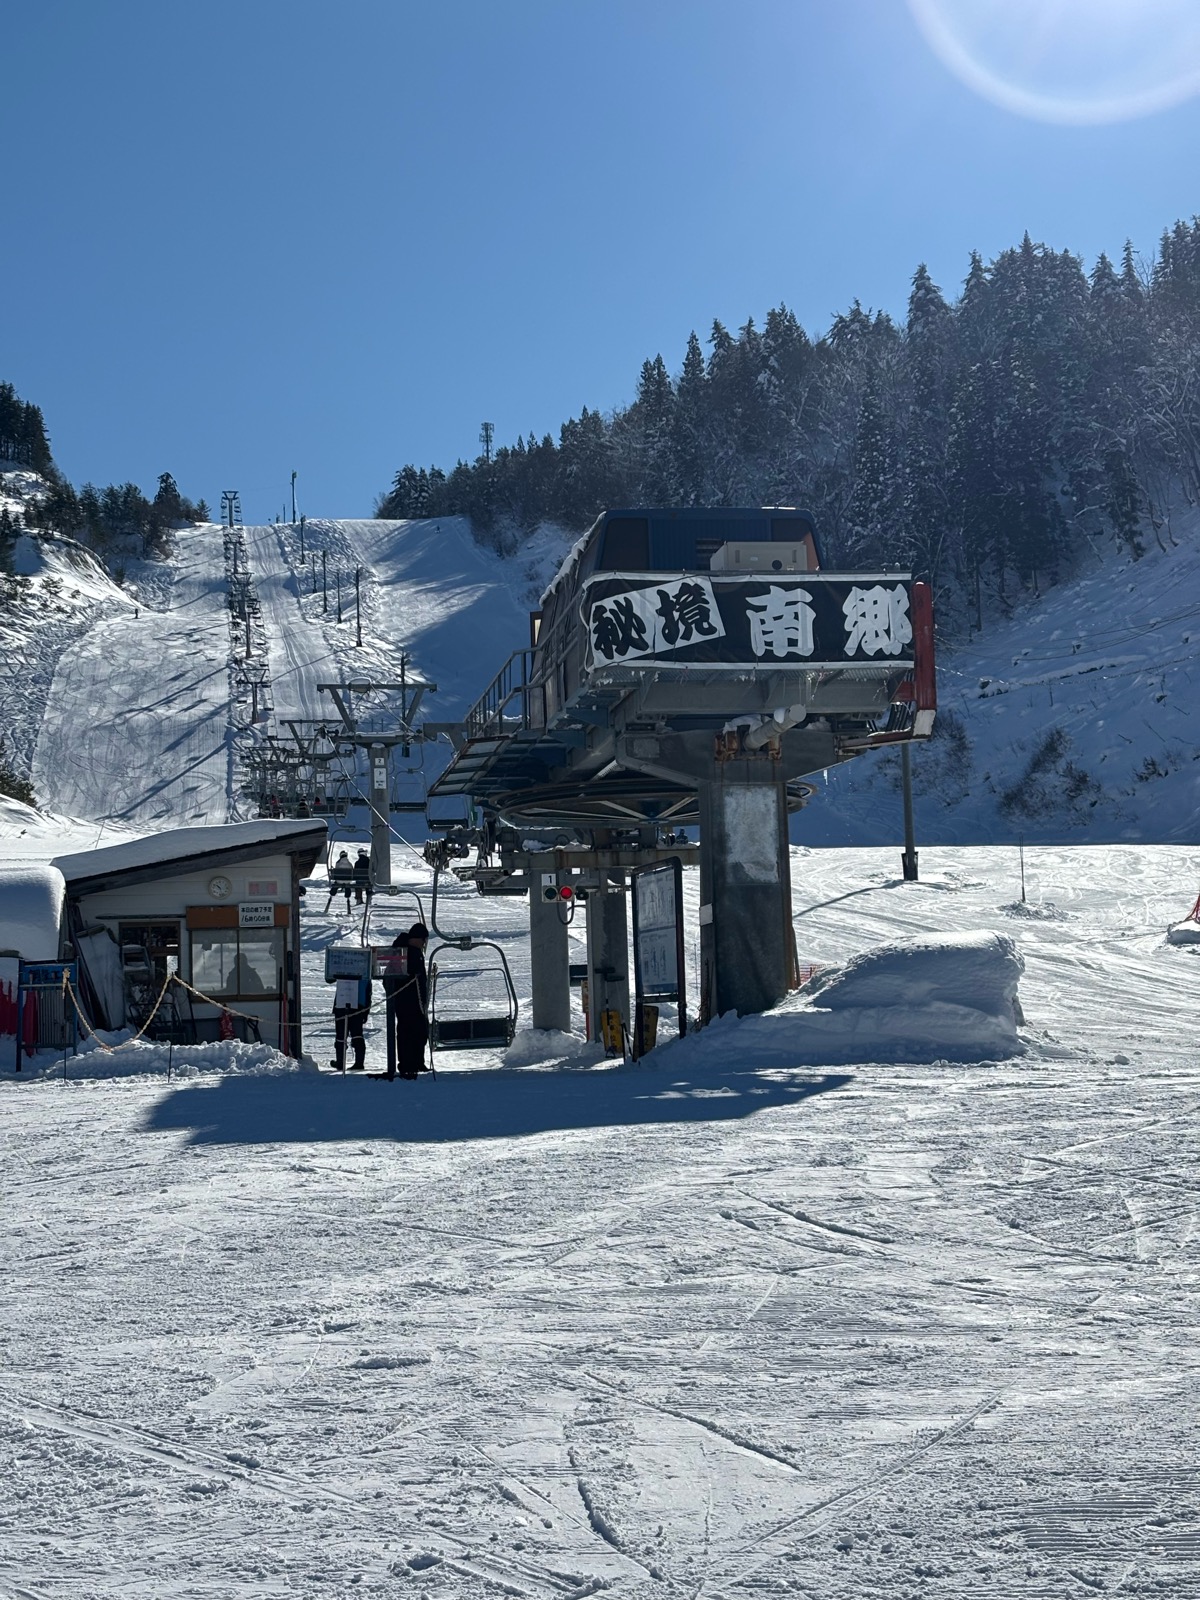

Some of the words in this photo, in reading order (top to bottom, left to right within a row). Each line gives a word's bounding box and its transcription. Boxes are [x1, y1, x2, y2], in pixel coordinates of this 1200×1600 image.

[593, 582, 718, 660] 秘境
[746, 584, 913, 657] 南郷
[548, 875, 552, 884] 1
